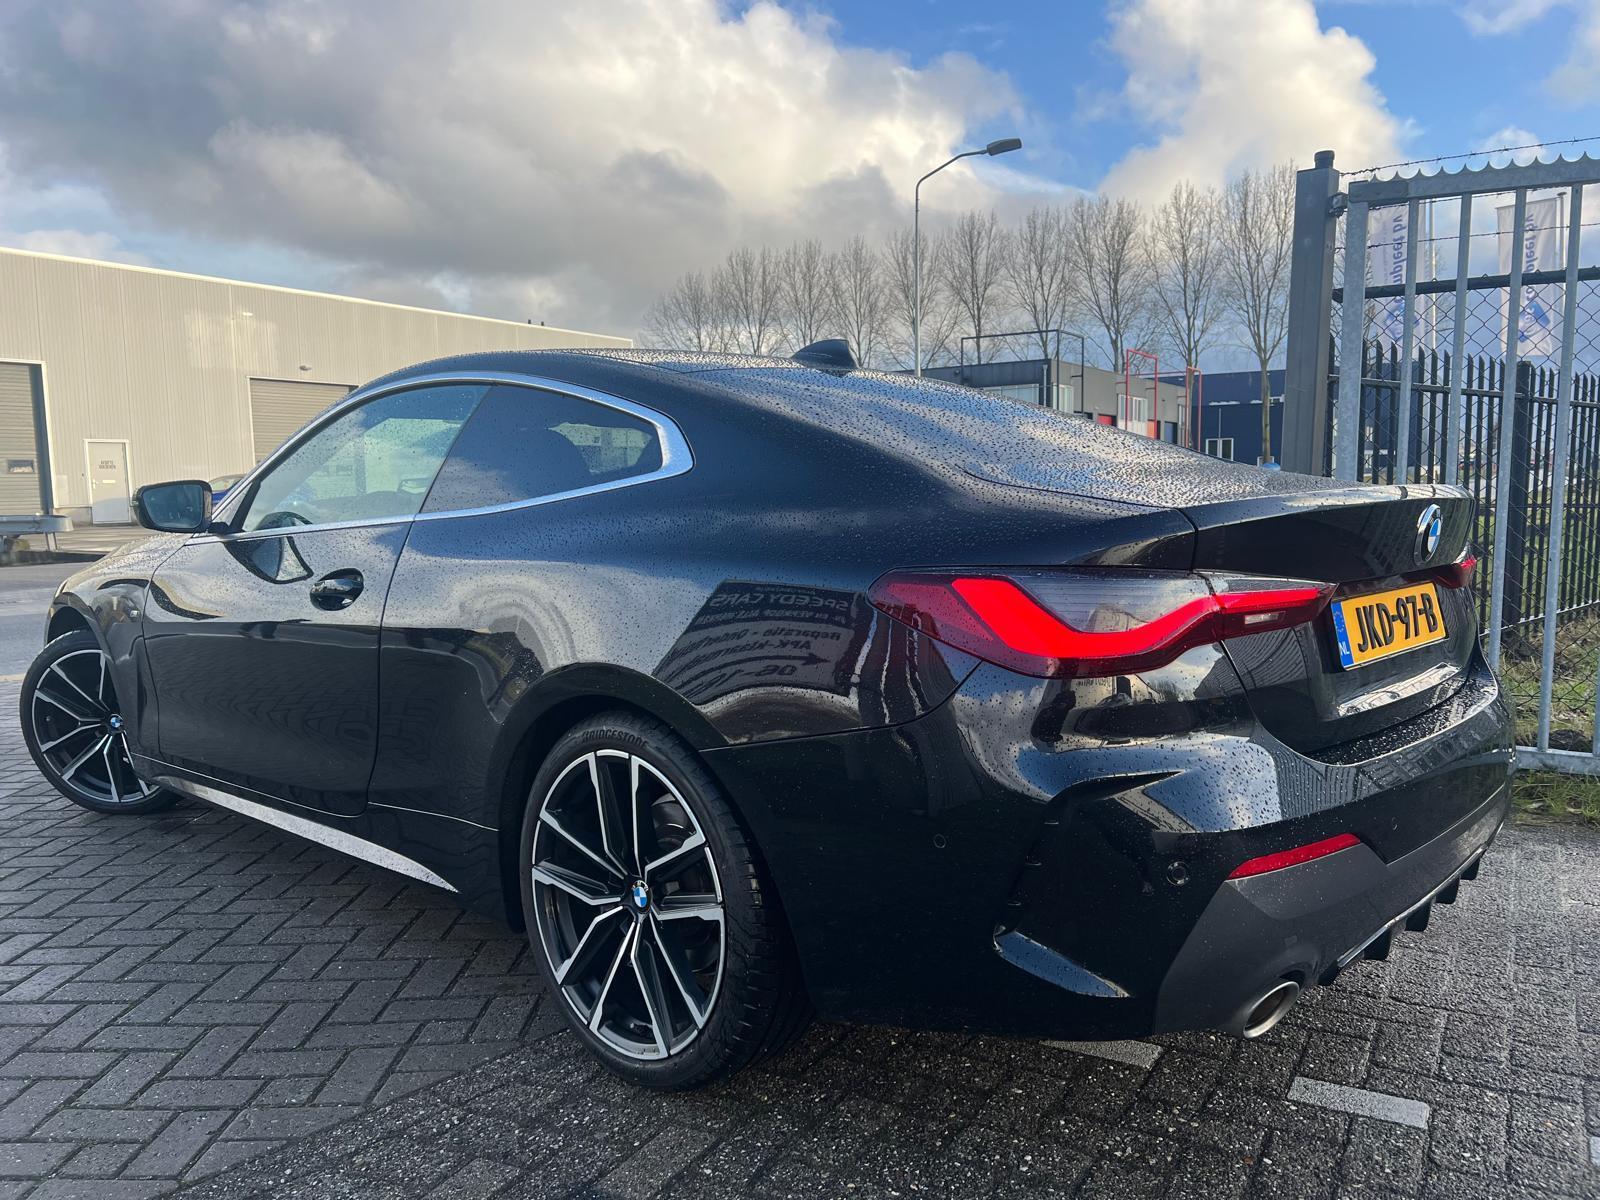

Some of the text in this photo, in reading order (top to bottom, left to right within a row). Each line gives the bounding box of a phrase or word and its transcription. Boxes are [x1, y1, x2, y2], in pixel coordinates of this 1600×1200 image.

[1355, 593, 1438, 653] JKD-97-B
[1339, 641, 1350, 656] NL
[582, 728, 649, 748] BRIDGESTONE
